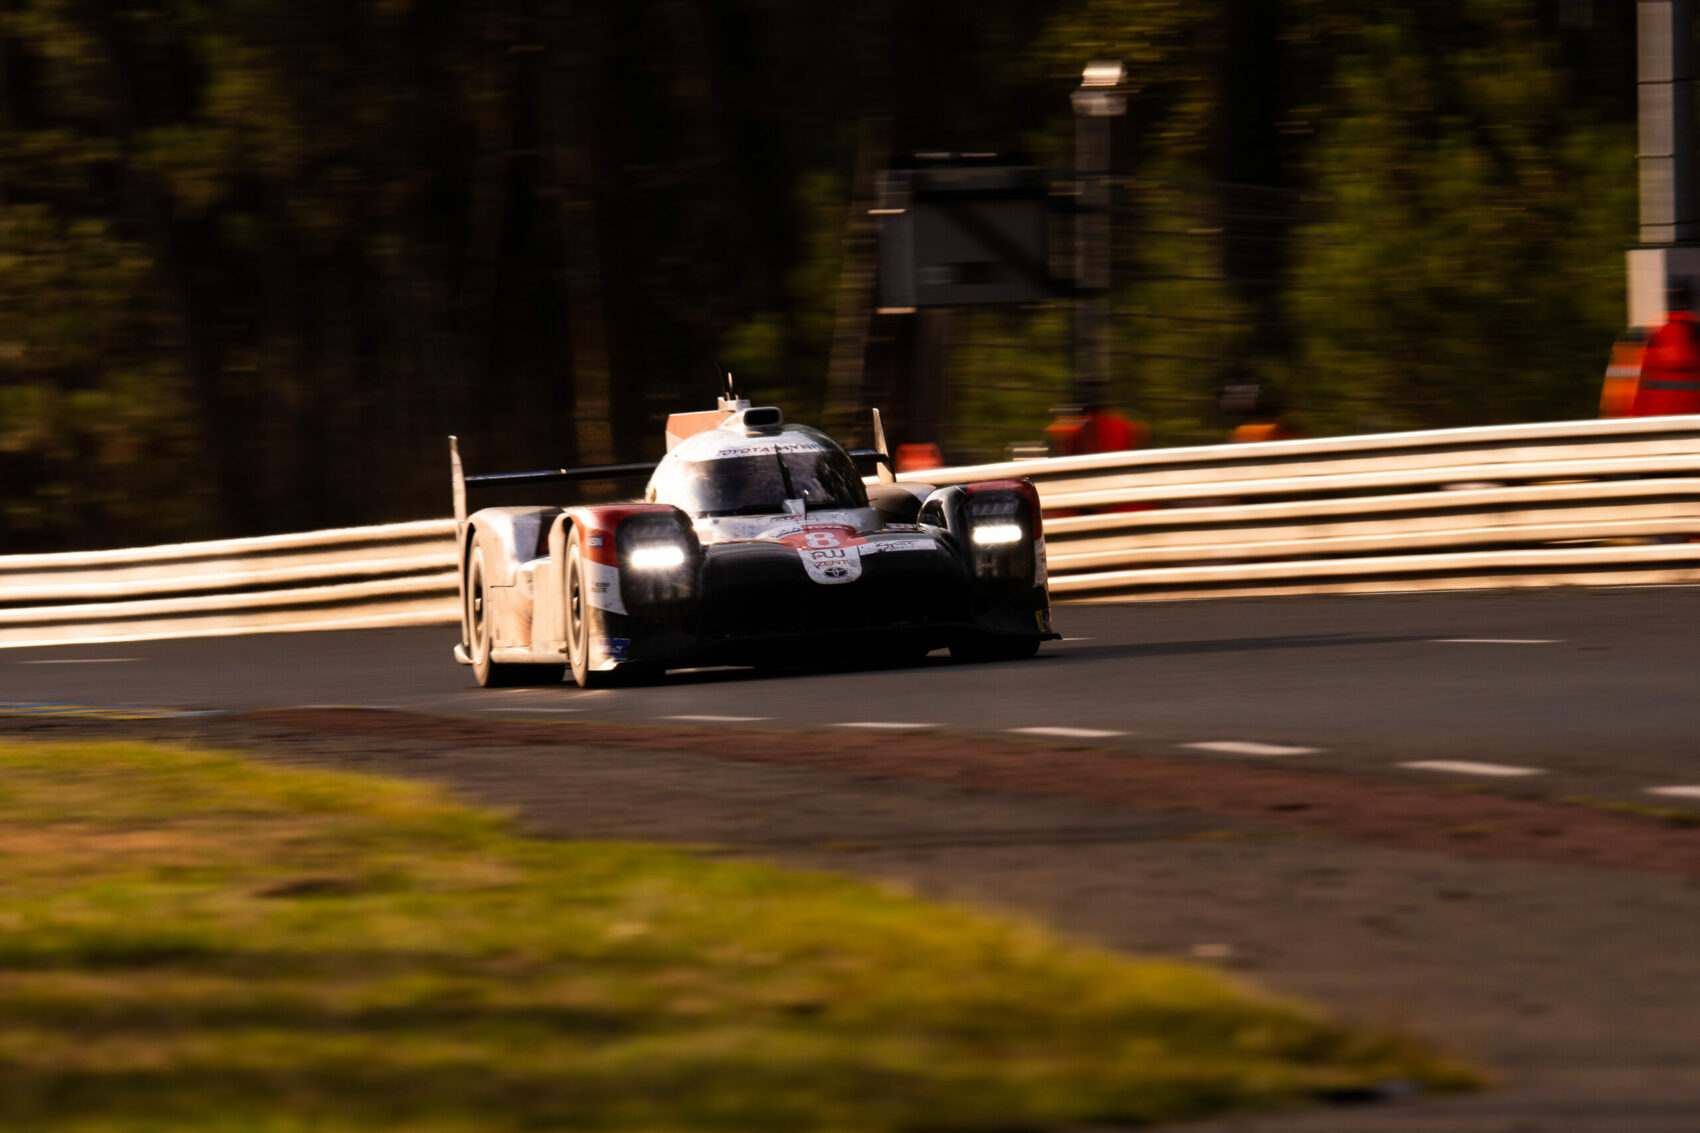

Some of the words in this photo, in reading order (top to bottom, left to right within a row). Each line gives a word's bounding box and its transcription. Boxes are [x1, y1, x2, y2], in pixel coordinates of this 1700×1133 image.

[717, 447, 770, 456] TOYOTA
[804, 532, 841, 548] 8
[815, 559, 849, 568] ZENT
